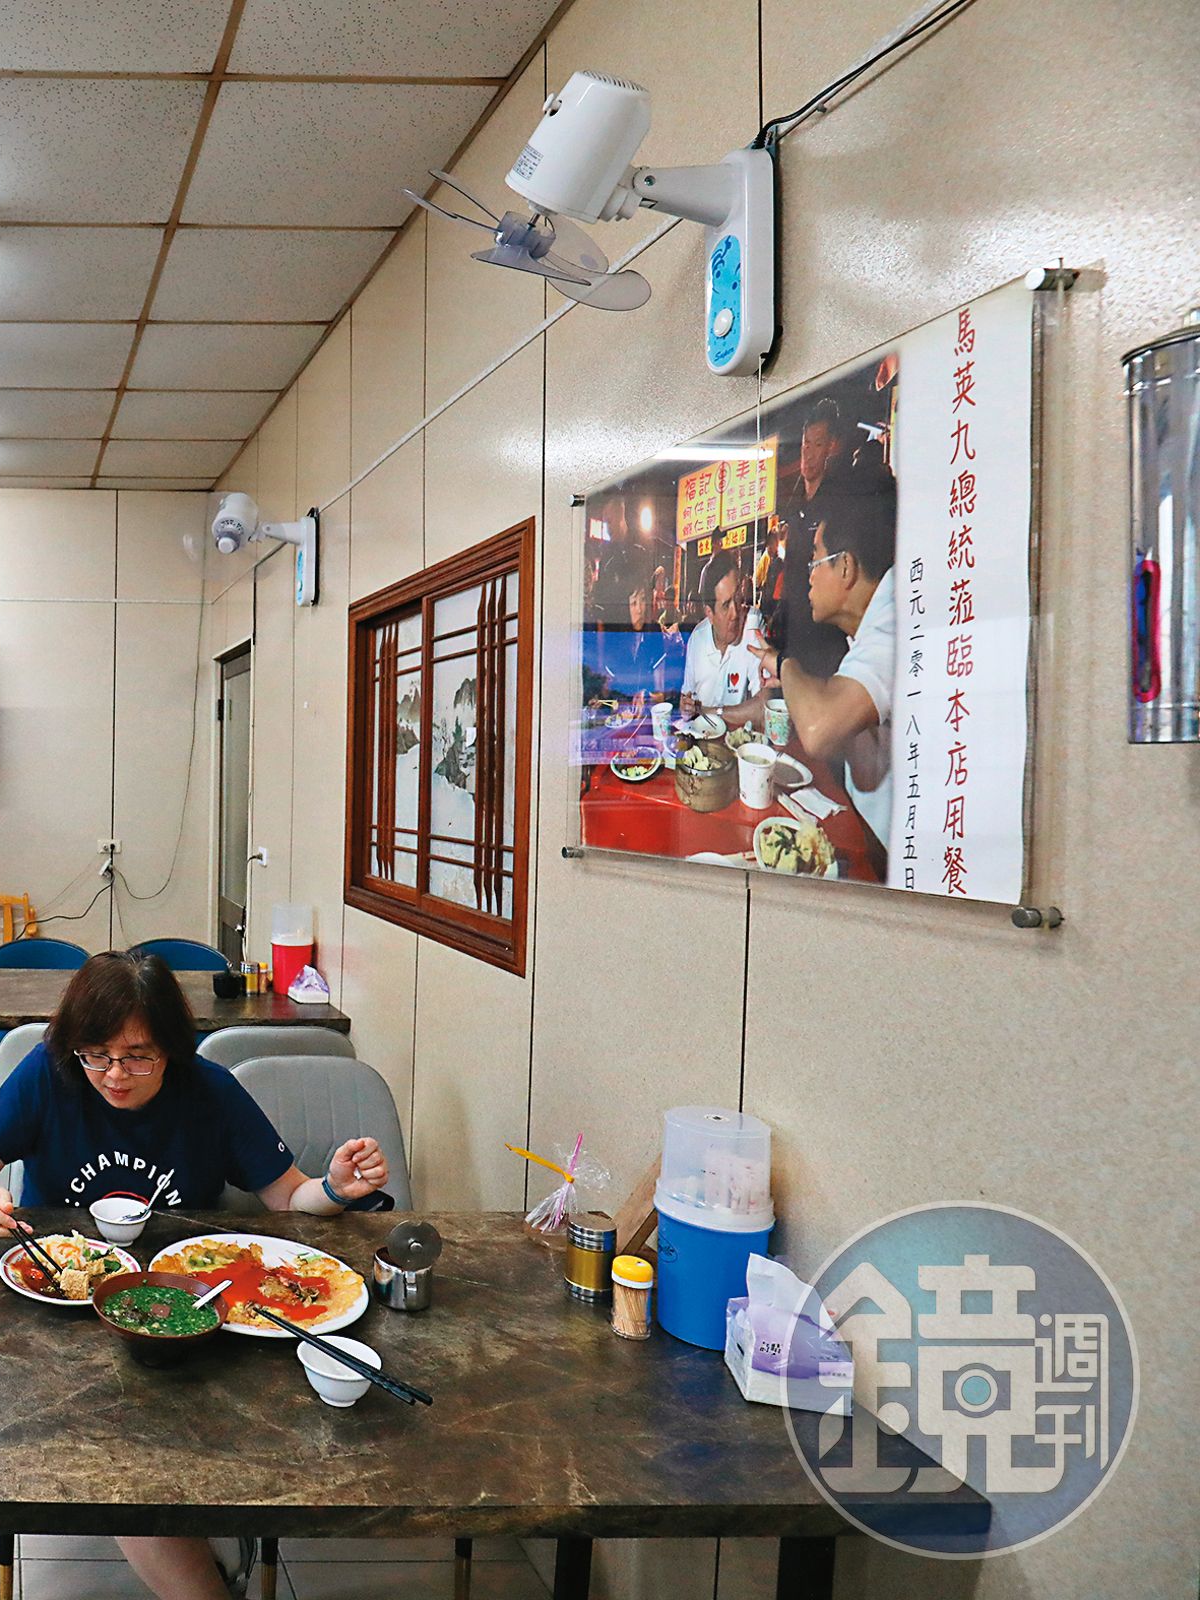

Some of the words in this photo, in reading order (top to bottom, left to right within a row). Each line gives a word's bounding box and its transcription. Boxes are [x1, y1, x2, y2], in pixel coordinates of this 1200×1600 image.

[902, 558, 925, 889] 西元二零一八年五月五日
[71, 1151, 182, 1206] CHAMPION
